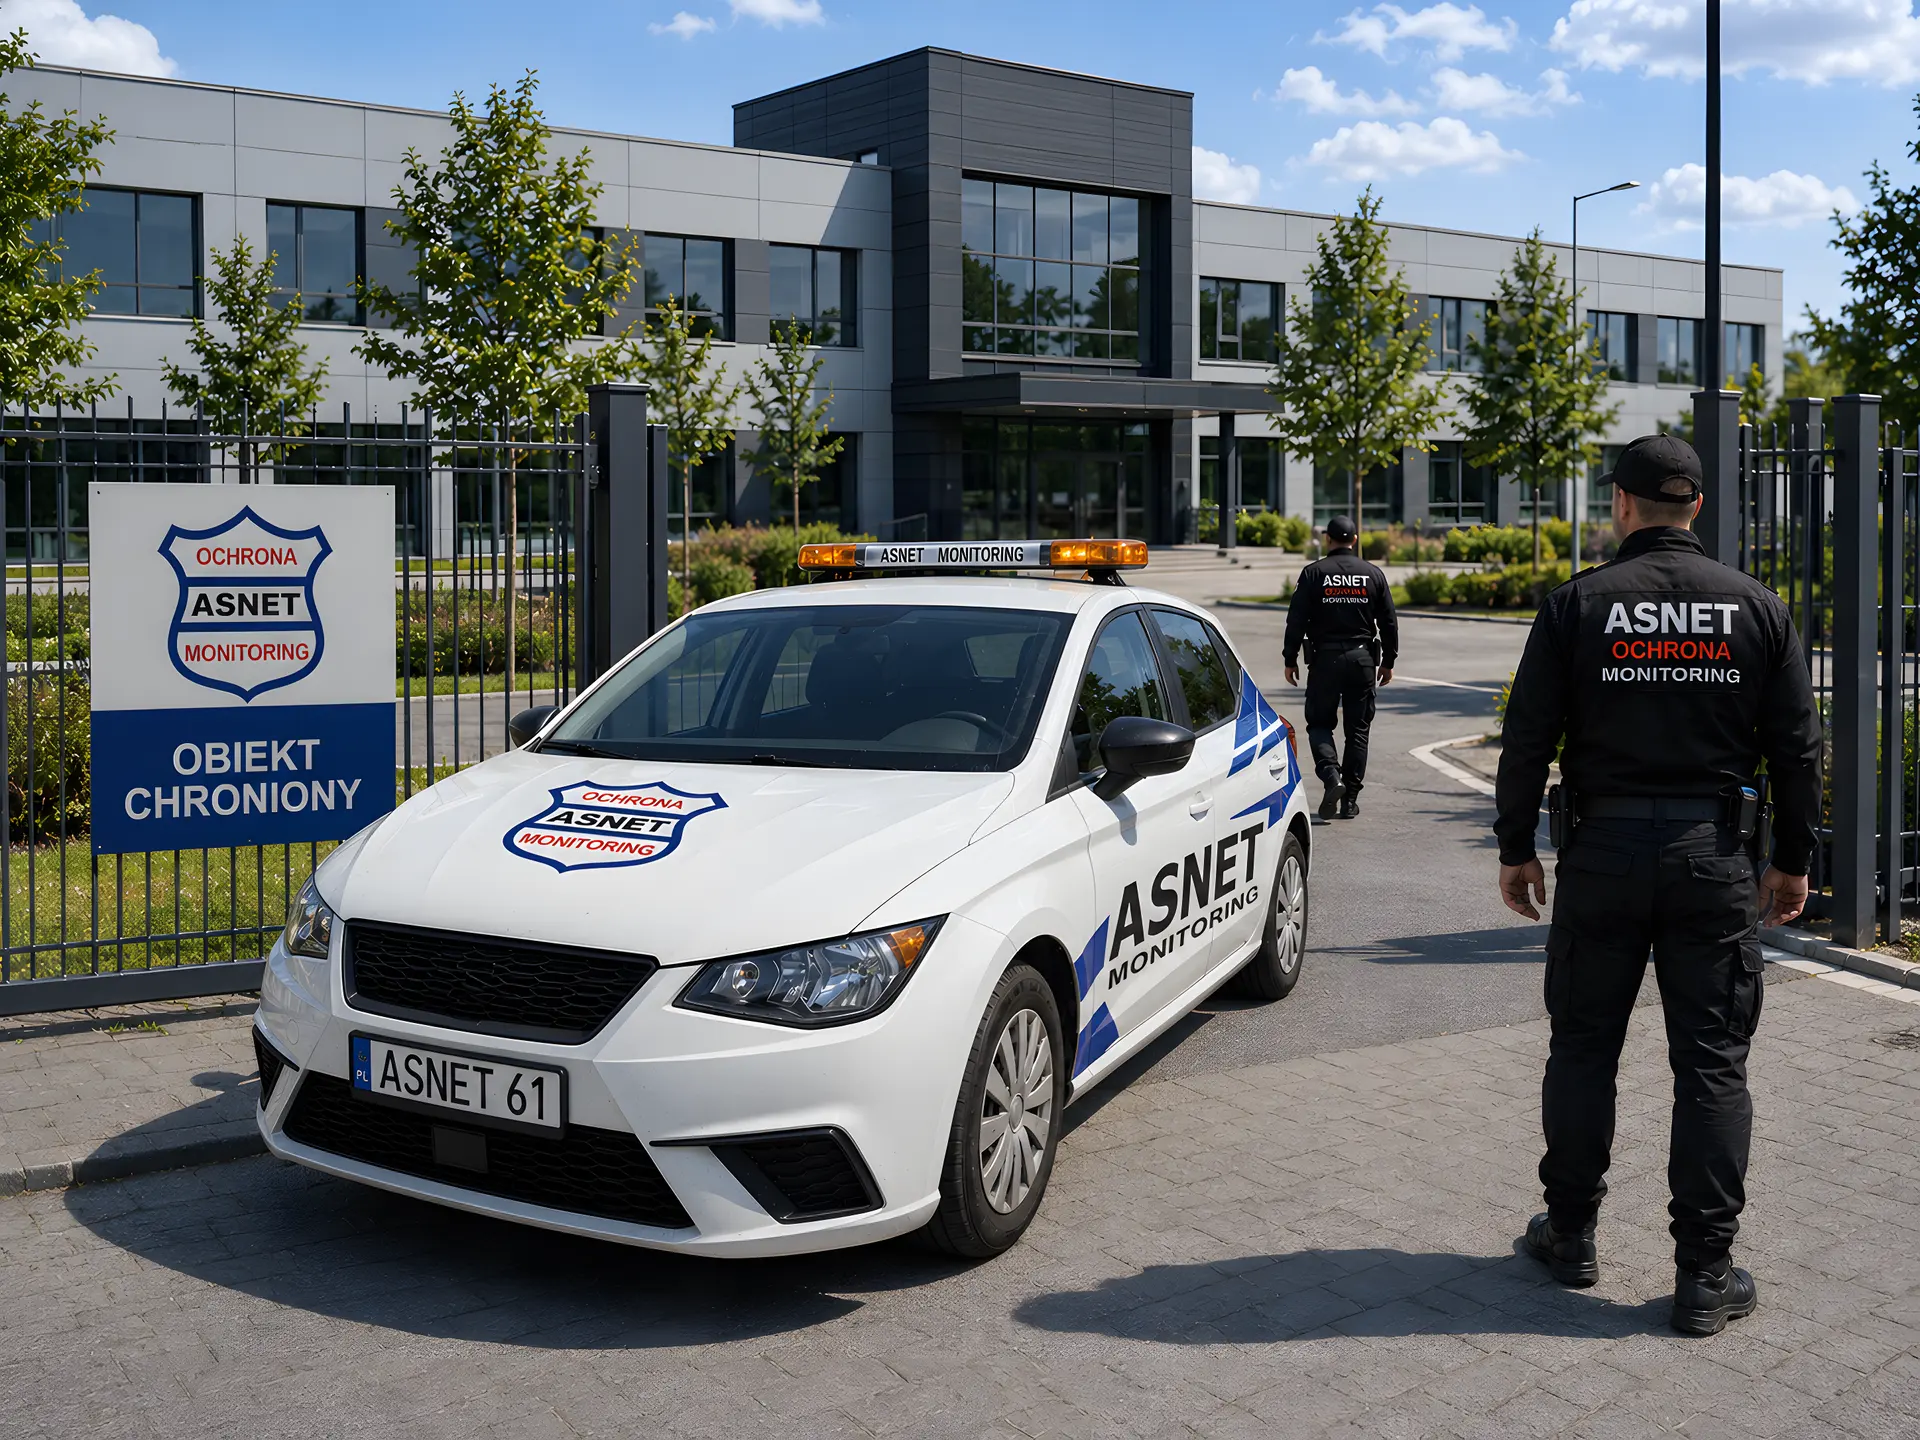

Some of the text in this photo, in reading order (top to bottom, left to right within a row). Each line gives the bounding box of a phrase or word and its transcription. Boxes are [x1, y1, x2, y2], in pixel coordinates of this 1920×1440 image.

[196, 547, 298, 566] OCHRONA
[880, 546, 1024, 563] ASNET MONITORING
[1322, 574, 1370, 587] ASNET
[191, 592, 301, 617] ASNET
[1604, 602, 1740, 635] ASNET
[184, 643, 309, 662] MONITORING
[1611, 640, 1732, 661] OCHRONA
[1602, 667, 1741, 684] MONITORING
[172, 738, 320, 776] OBIEKT
[124, 778, 362, 820] CHRONIONY
[582, 791, 684, 810] OCHRONA
[546, 811, 671, 833] ASNET
[518, 833, 655, 856] MONITORING
[1108, 821, 1264, 962] ASNET
[1108, 885, 1258, 990] MONITORING
[356, 1069, 369, 1083] PL
[379, 1049, 544, 1121] ASNET 61
